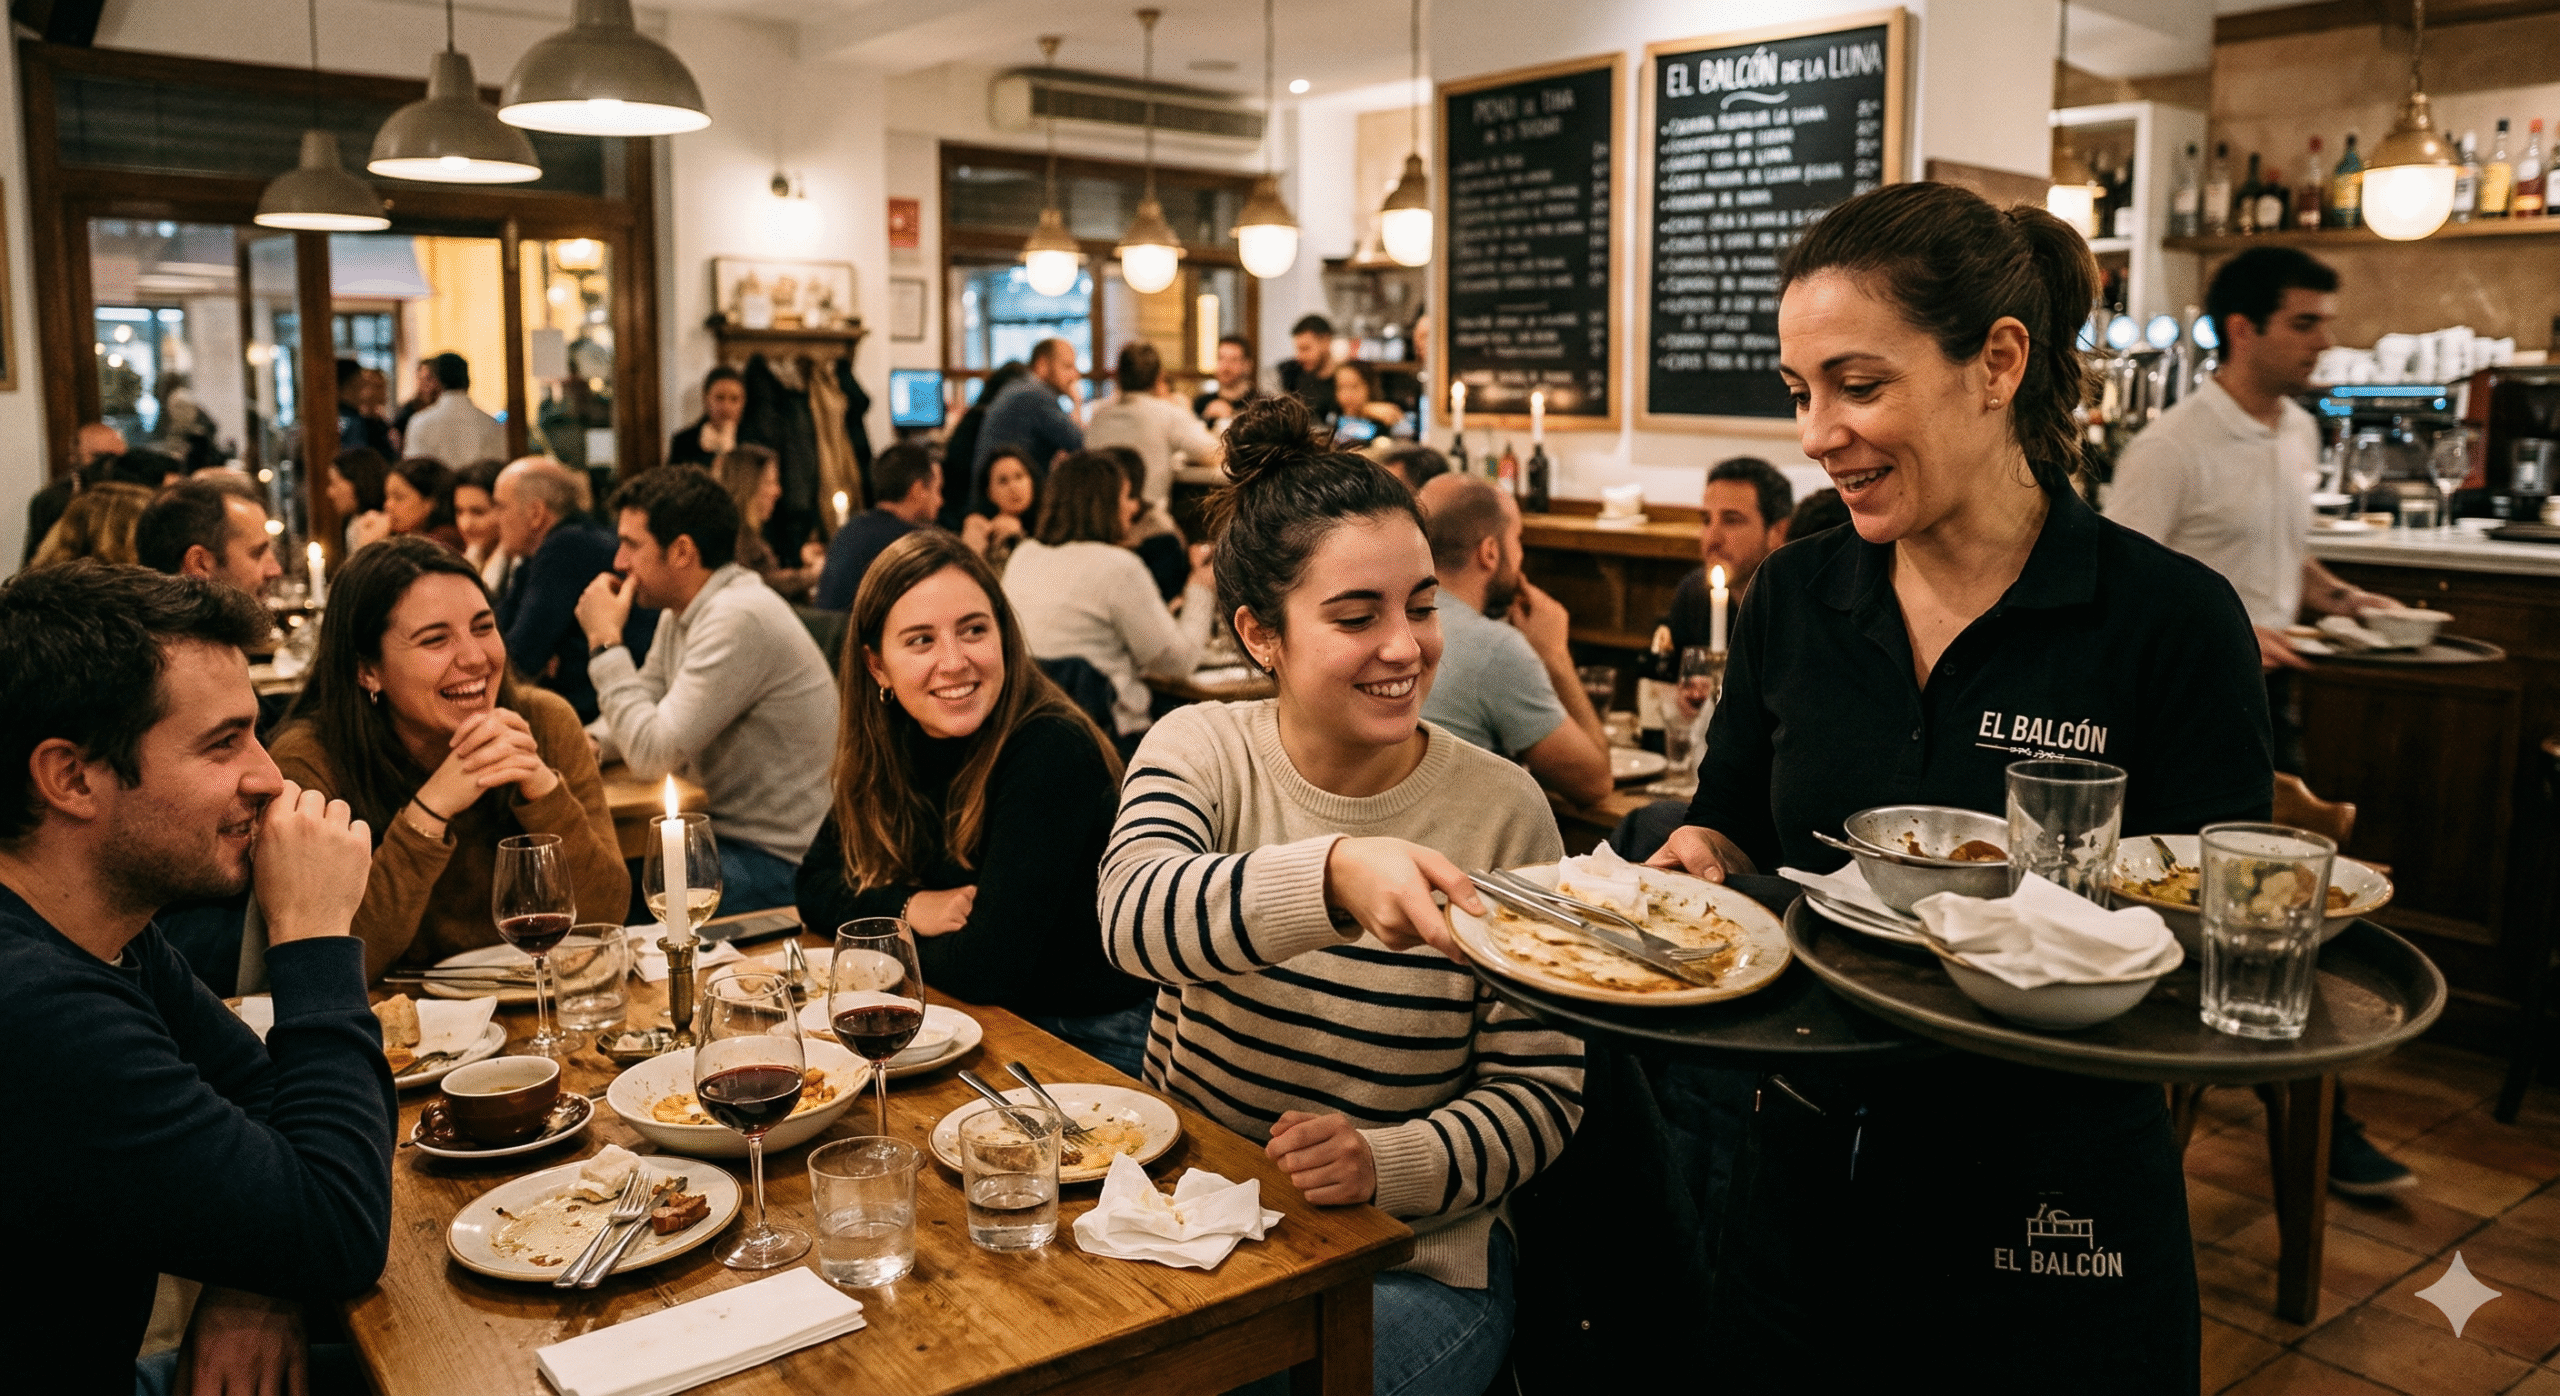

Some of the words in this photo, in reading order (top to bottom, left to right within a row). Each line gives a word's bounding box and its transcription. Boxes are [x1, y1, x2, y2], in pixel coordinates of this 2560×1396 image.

[1666, 63, 1695, 98] EL
[1699, 46, 1778, 94] BALCÓN
[1780, 59, 1804, 84] DE
[1803, 56, 1827, 82] LA
[1828, 40, 1883, 80] LUNA
[1979, 711, 2006, 740] EL
[2011, 714, 2108, 755] BALCÓN
[1994, 1247, 2021, 1271] EL
[2030, 1246, 2124, 1278] BALCÓN
